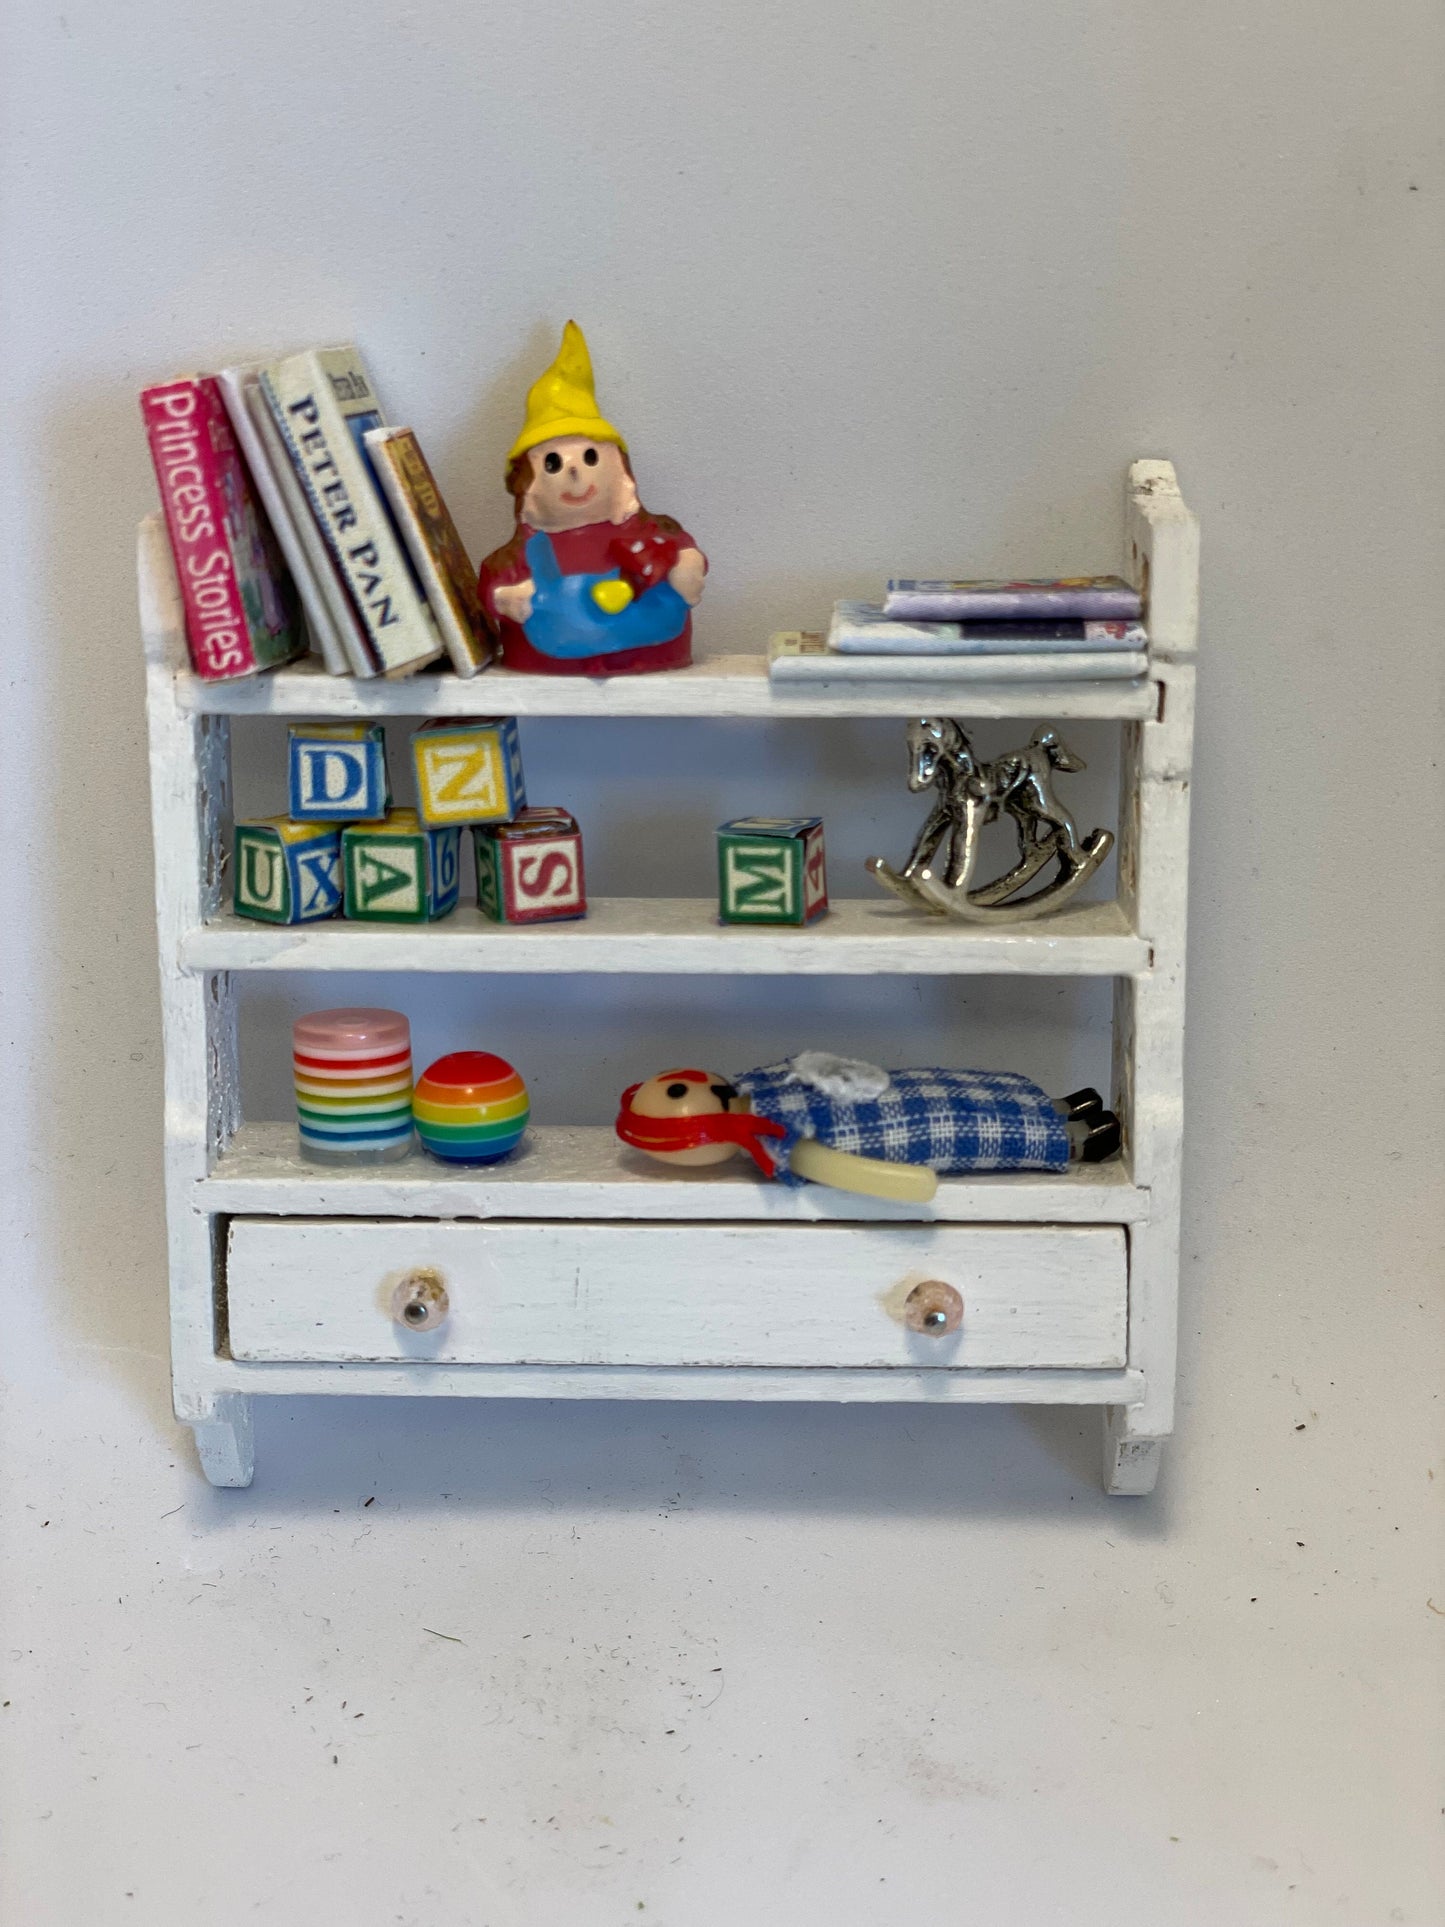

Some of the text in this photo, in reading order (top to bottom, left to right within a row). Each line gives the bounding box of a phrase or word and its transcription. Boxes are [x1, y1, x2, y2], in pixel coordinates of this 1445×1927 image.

[147, 390, 245, 672] Princess Stories
[288, 392, 360, 534] PETER
[347, 539, 399, 629] PAN
[304, 749, 363, 804] D
[243, 844, 280, 903] U
[301, 852, 342, 911] X
[359, 847, 413, 908] A
[518, 851, 573, 900] S
[734, 848, 785, 912] M
